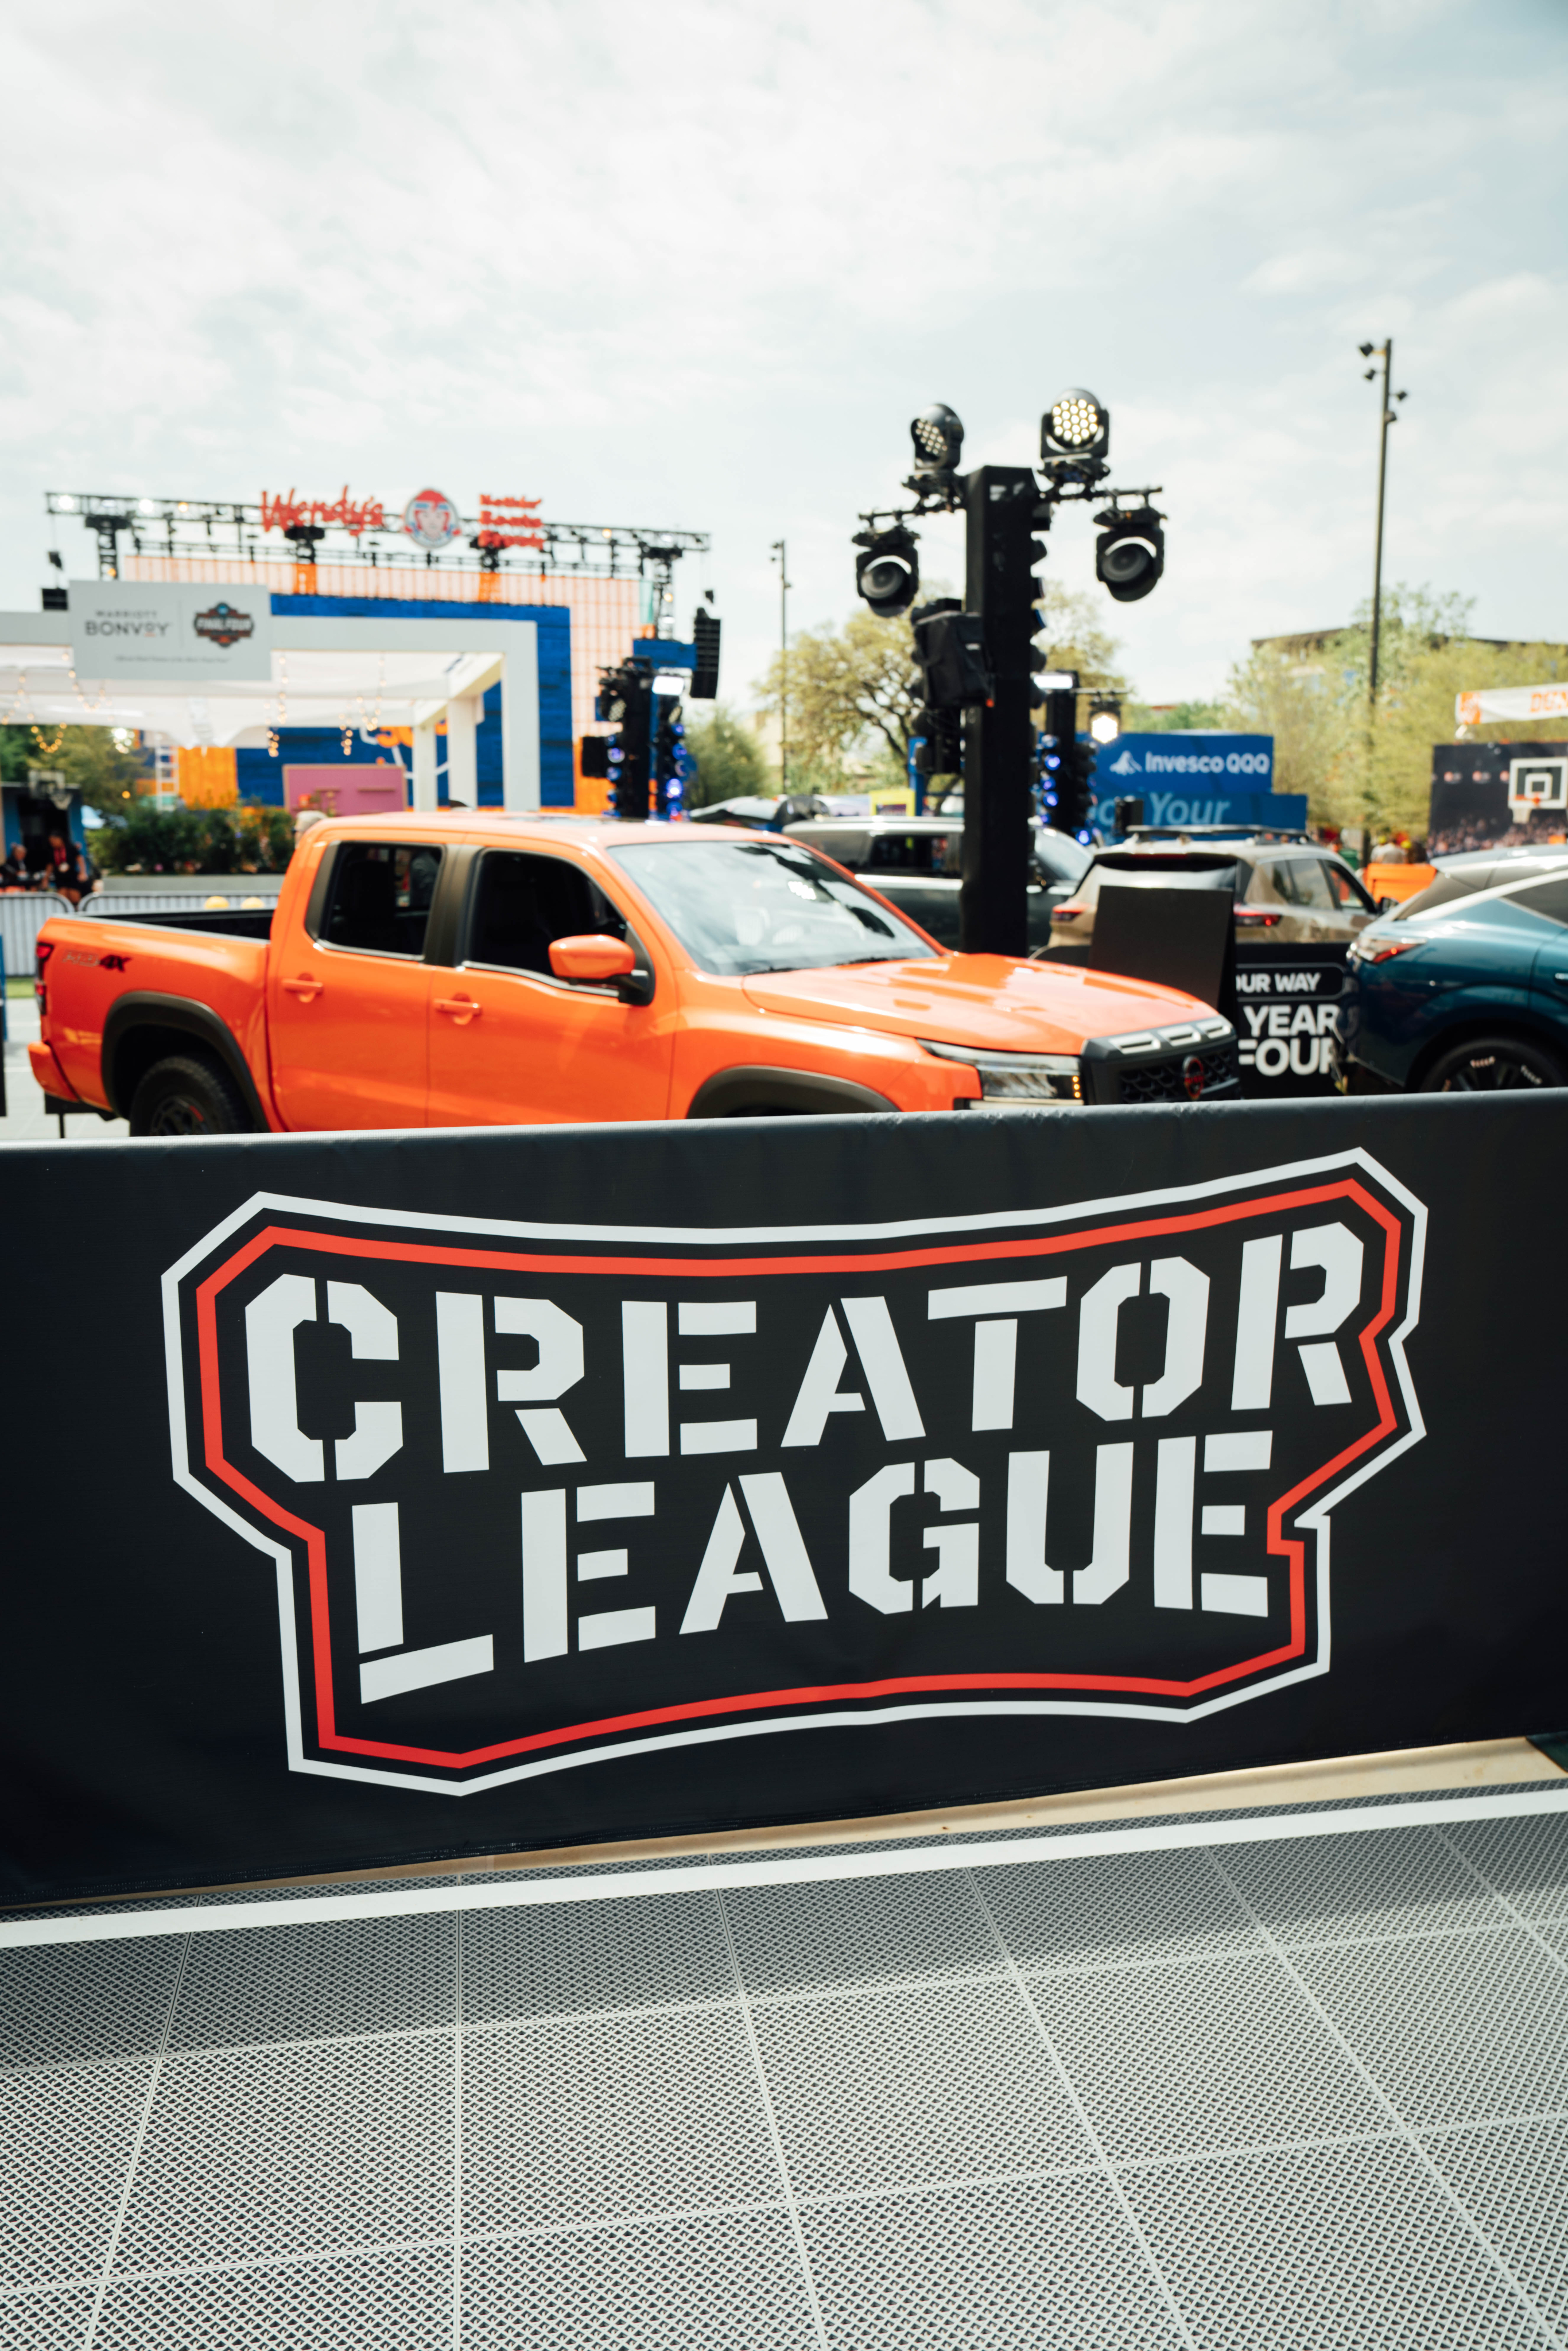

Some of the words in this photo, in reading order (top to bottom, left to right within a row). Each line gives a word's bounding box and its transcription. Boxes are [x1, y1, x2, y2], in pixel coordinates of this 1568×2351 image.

[261, 485, 383, 537] Wendy's
[1145, 751, 1225, 773] Invesco
[1226, 752, 1270, 774] QQQ
[1150, 792, 1230, 825] Your
[1274, 972, 1321, 992] WAY
[244, 1221, 1364, 1483] CREATOR
[352, 1430, 1273, 1704] LEAGUE
